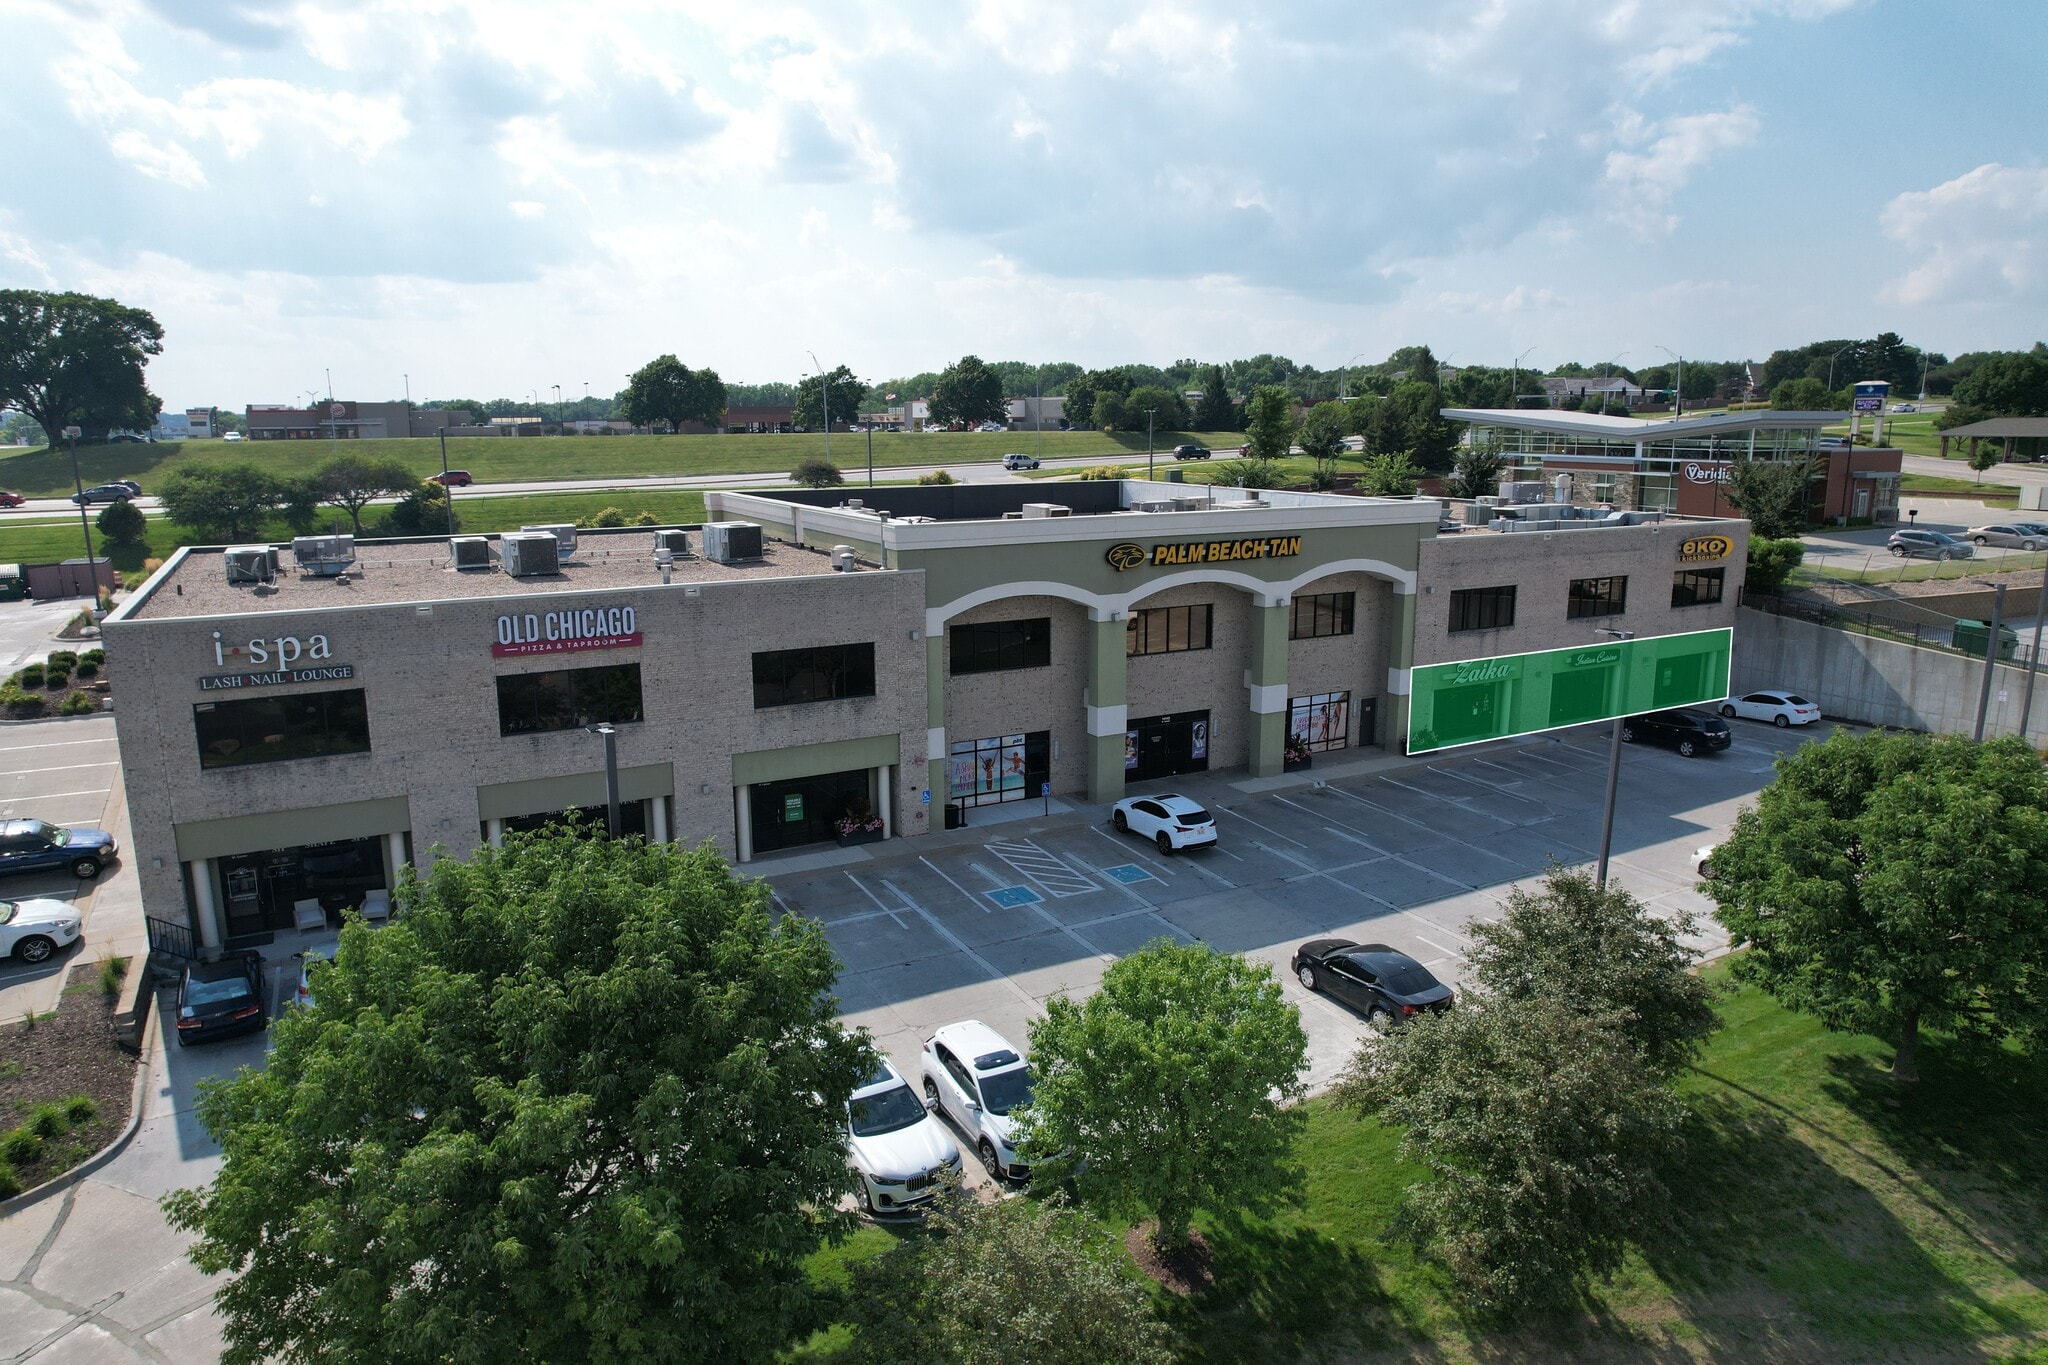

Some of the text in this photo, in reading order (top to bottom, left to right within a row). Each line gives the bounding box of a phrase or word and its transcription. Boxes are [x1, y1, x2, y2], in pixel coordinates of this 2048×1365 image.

[1154, 536, 1301, 565] PALM BEACH TAN
[497, 606, 636, 645] OLD CHICAGO
[520, 638, 617, 652] PIZZA & TAPROOM
[202, 667, 352, 690] LASH NAIL LOUNGE
[1452, 658, 1511, 685] Zaika
